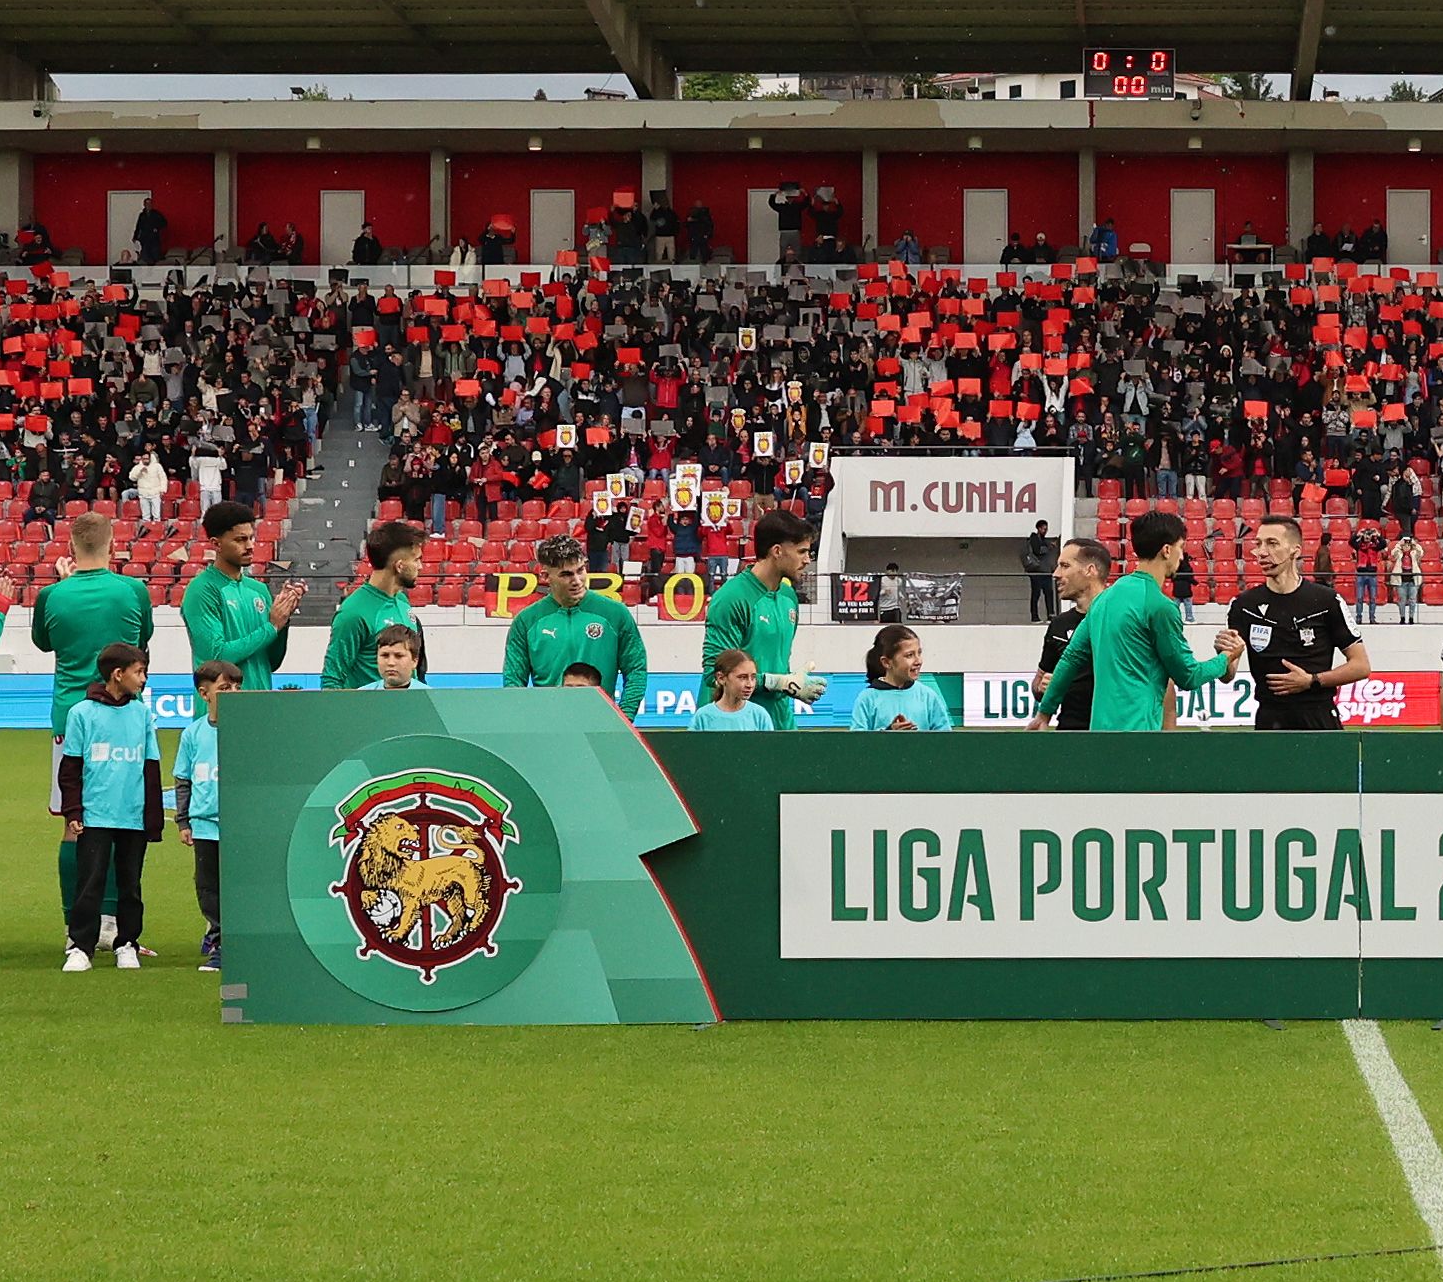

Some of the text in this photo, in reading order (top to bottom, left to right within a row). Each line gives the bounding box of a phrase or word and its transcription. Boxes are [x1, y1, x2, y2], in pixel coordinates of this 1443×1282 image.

[1093, 52, 1107, 71] 0
[1151, 52, 1166, 71] 0
[1114, 76, 1172, 94] 00 min
[842, 581, 870, 602] 12
[984, 680, 1043, 719] LIG
[831, 828, 995, 922] LIGA
[1019, 827, 1417, 923] PORTUGAL
